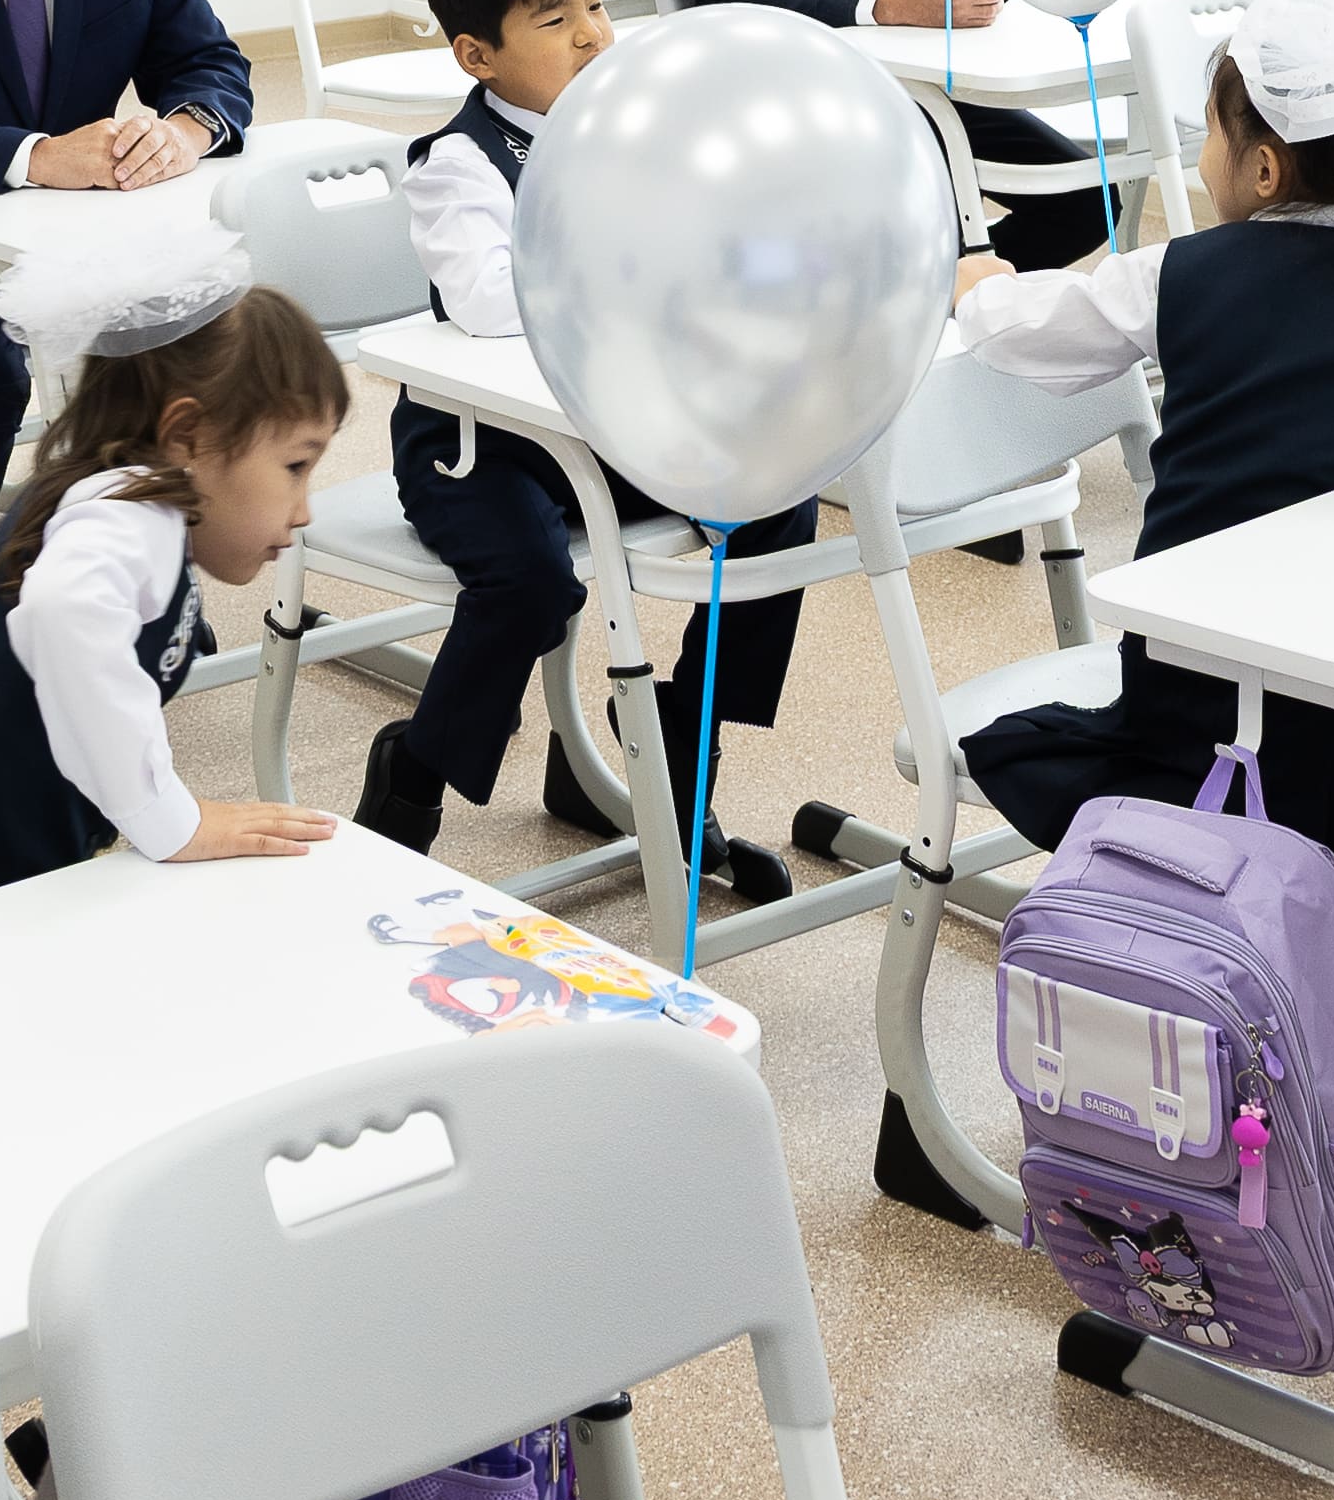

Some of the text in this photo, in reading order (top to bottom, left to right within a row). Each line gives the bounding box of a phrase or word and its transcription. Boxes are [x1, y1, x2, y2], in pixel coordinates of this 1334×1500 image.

[1037, 1057, 1058, 1074] SEN
[1084, 1096, 1132, 1122] SAIERNA
[1155, 1101, 1178, 1118] SEN
